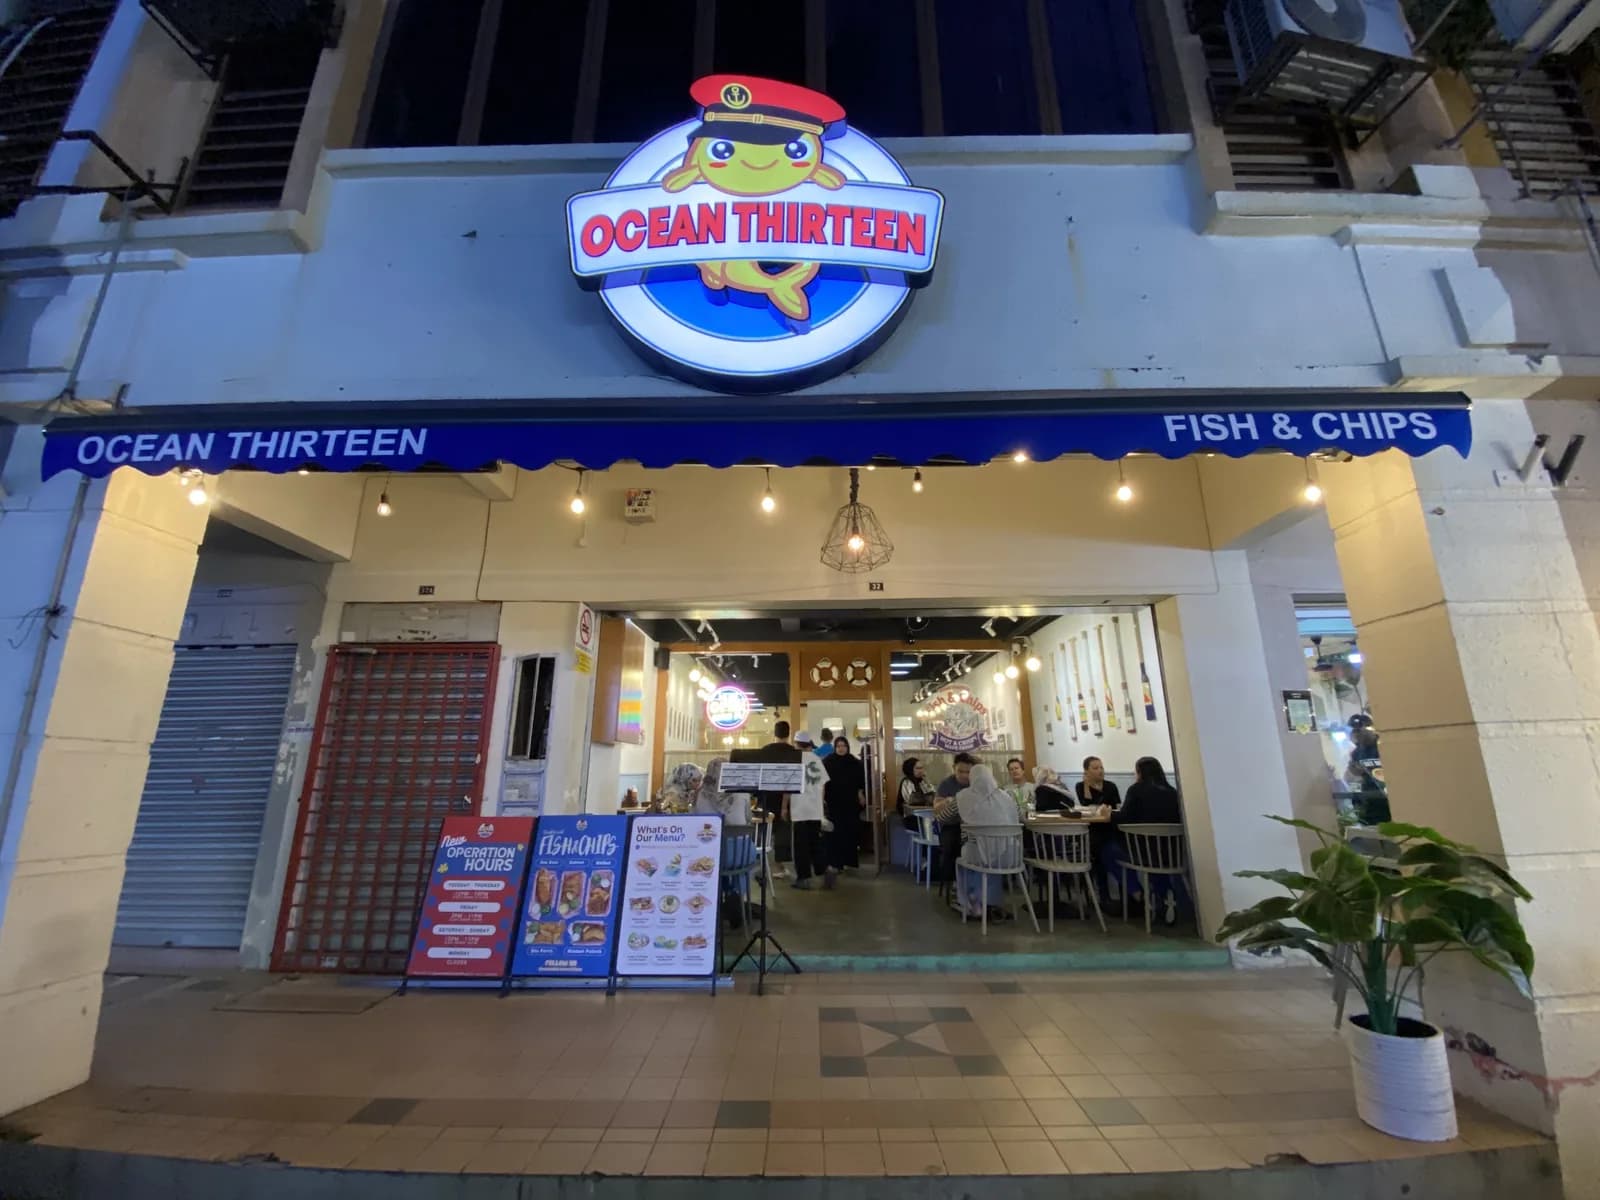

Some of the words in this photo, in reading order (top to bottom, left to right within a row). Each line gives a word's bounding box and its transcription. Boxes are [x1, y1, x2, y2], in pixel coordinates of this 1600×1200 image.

[580, 202, 727, 258] OCEAN
[732, 201, 926, 257] THIRTEEN
[1163, 412, 1260, 442] FISH
[1272, 412, 1302, 441] &
[1312, 411, 1438, 441] CHIPS
[76, 432, 216, 465] OCEAN
[227, 427, 428, 460] THIRTEEN
[637, 825, 668, 834] What's
[670, 825, 683, 834] On
[441, 835, 467, 848] New
[636, 834, 653, 842] Our
[655, 834, 686, 842] Menu?
[446, 847, 516, 858] OPERATION
[464, 859, 514, 872] HOURS
